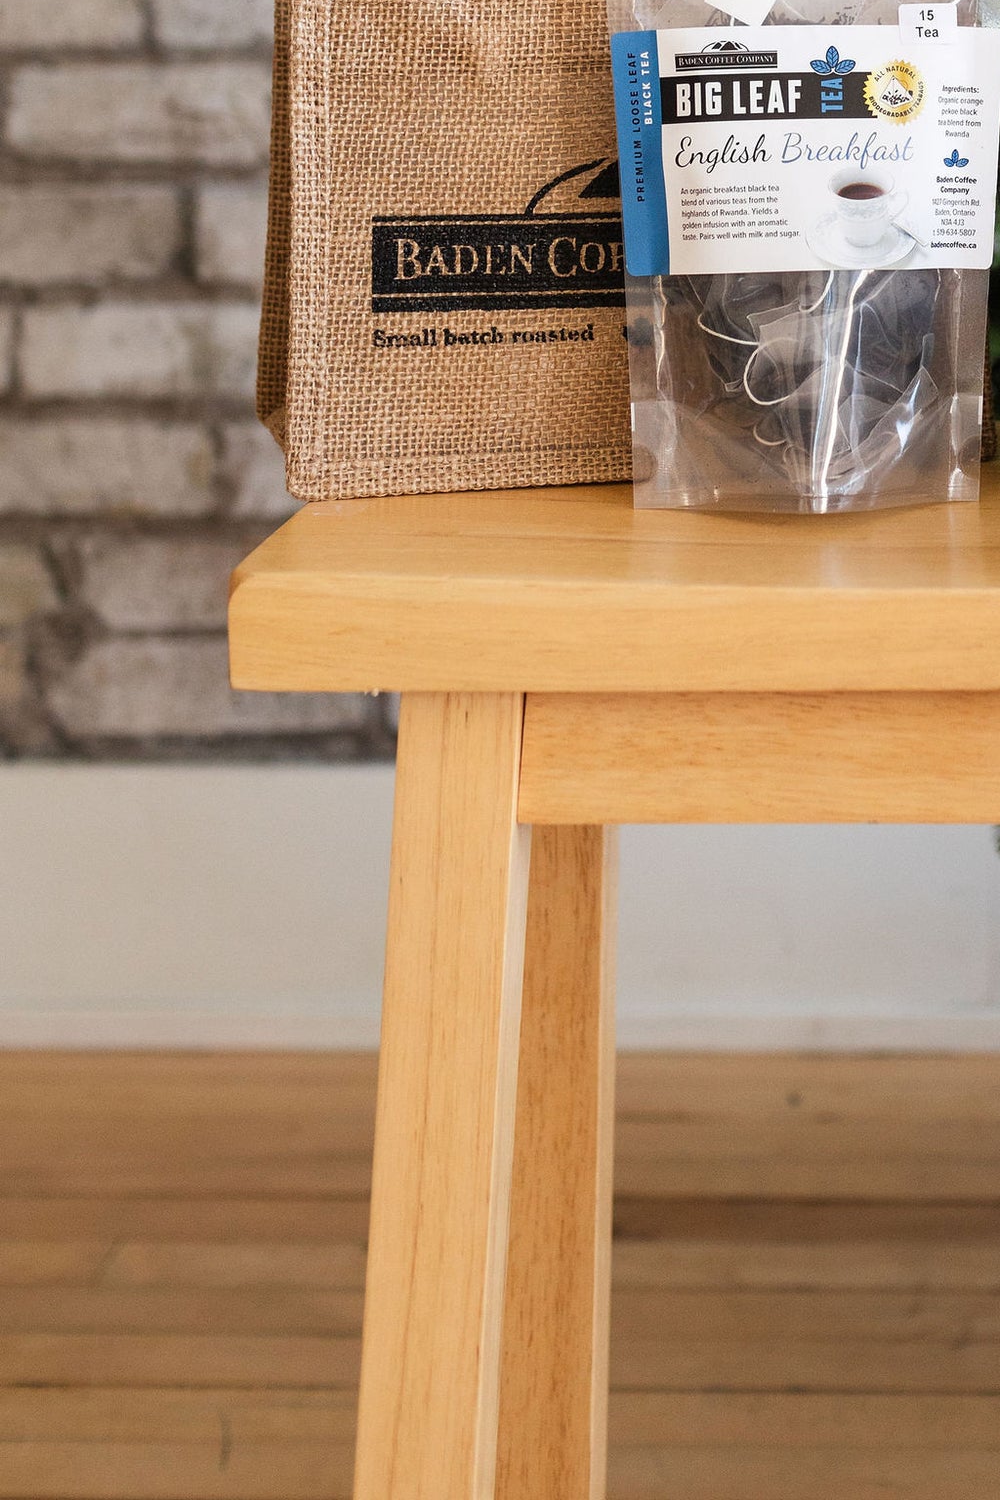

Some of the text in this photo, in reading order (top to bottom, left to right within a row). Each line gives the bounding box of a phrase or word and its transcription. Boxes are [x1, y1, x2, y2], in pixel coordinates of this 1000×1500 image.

[919, 10, 935, 21] 15
[915, 26, 939, 38] Tea
[678, 55, 773, 66] BADEN COFFEE COMPANY
[874, 65, 916, 82] ALL NATURAL
[640, 51, 653, 125] BLACK TEA
[942, 85, 980, 94] Ingredients:
[676, 79, 802, 117] BIG LEAF
[820, 77, 844, 113] TEA
[869, 96, 913, 118] BIODEGRADABLE
[959, 98, 984, 106] orange
[959, 108, 978, 116] black
[627, 52, 645, 202] PREMIUM LOOSE LEAF
[945, 130, 970, 138] Rwanda
[675, 132, 914, 174] English Breakfast
[954, 176, 977, 184] Coffee
[689, 187, 712, 196] organic
[714, 185, 746, 193] breakfast
[940, 186, 970, 195] Company
[698, 198, 705, 206] of
[681, 210, 710, 219] highlands
[711, 209, 719, 217] of
[720, 208, 750, 216] Rwanda.
[751, 207, 773, 215] Yields
[952, 209, 976, 217] Ontario
[682, 221, 702, 231] golden
[703, 220, 729, 228] infusion
[699, 232, 715, 240] Pairs
[716, 231, 730, 239] well
[732, 231, 747, 239] with
[748, 230, 763, 238] milk
[765, 230, 778, 238] and
[780, 231, 801, 239] sugar.
[930, 241, 977, 249] badencoffee.ca
[392, 237, 537, 280] BADEN
[372, 323, 595, 348] Small batch roasted
